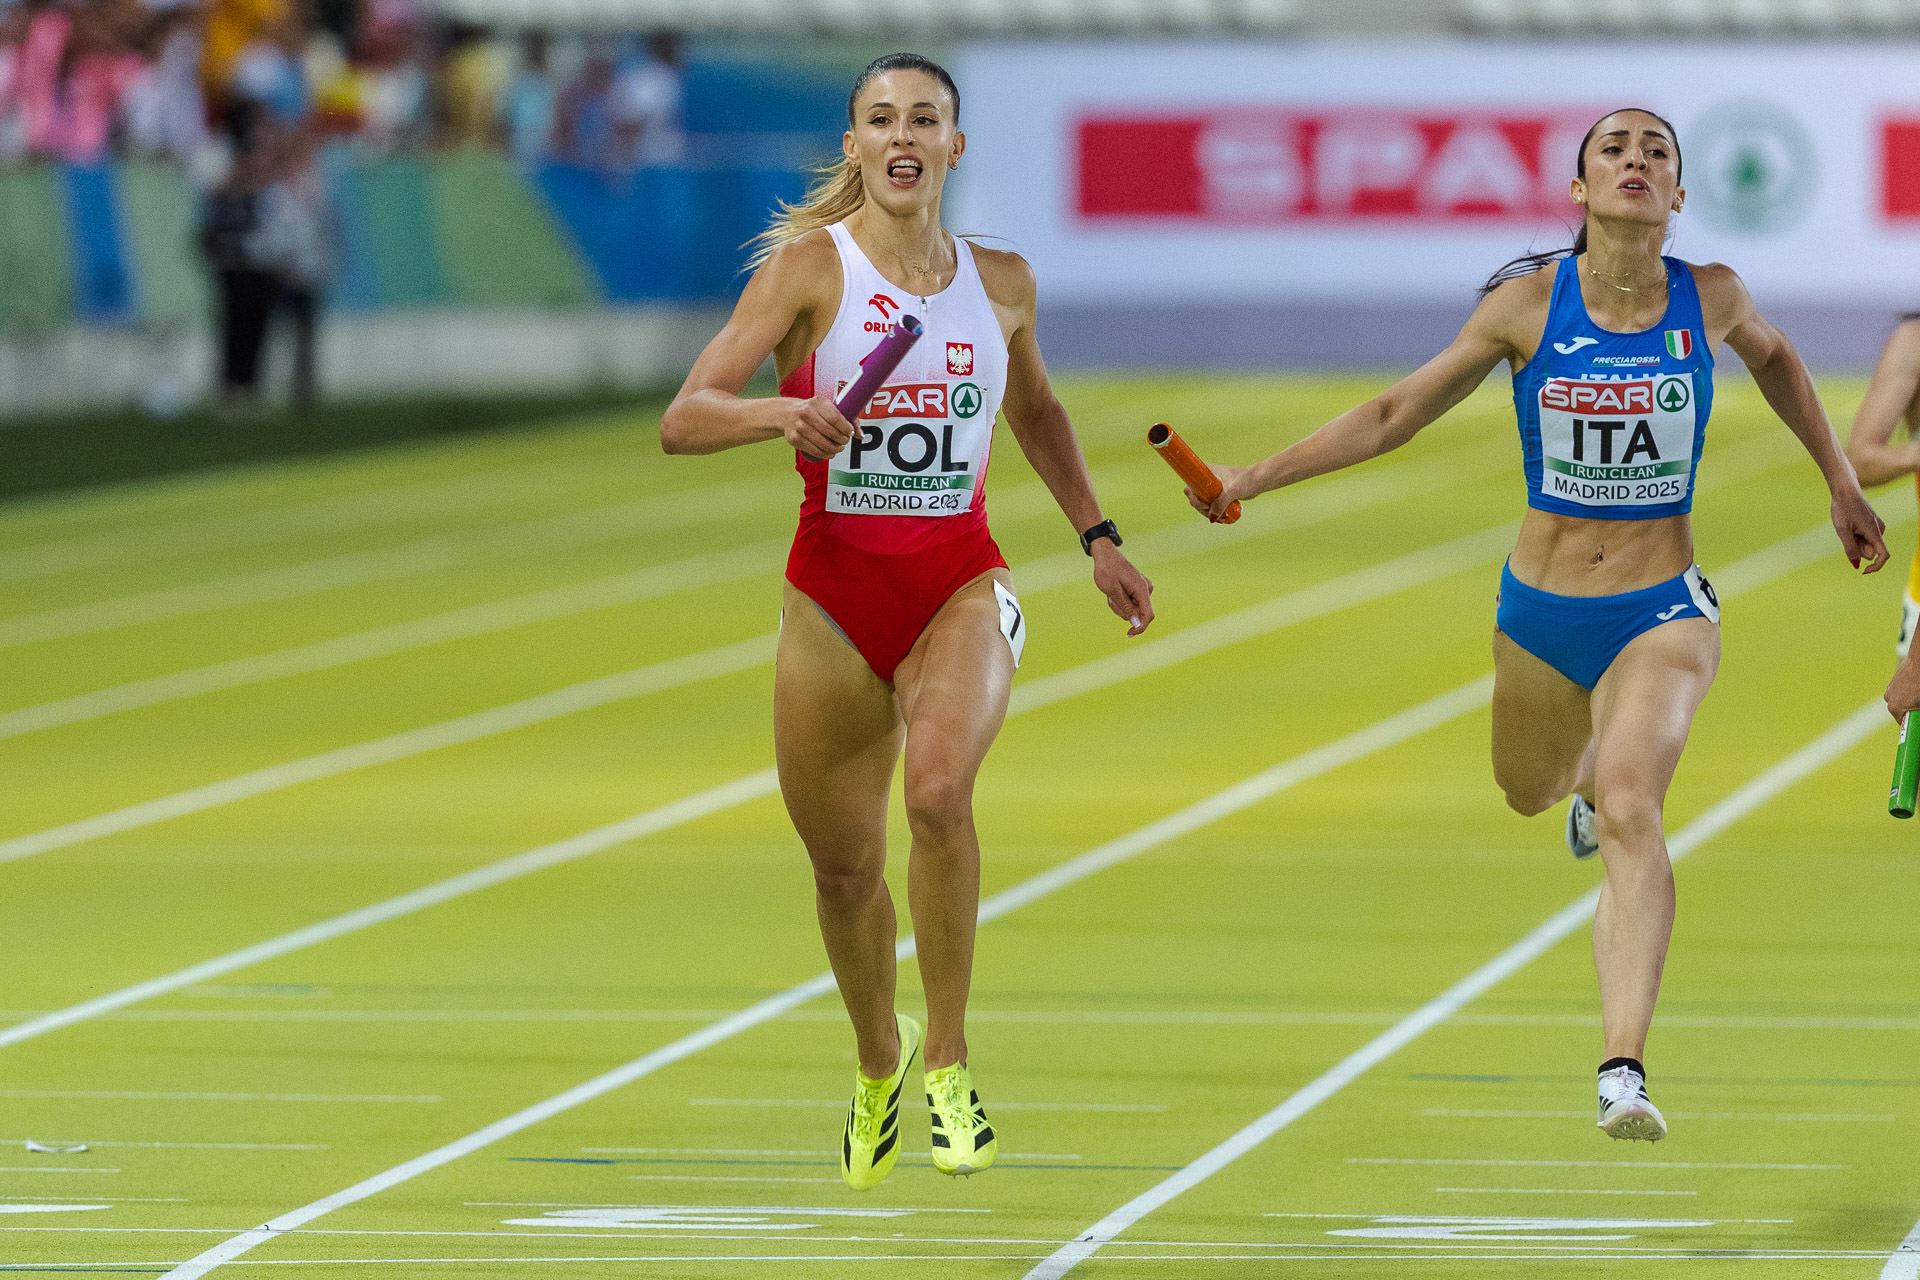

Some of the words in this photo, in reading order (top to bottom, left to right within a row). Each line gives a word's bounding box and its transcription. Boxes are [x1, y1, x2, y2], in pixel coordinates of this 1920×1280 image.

[1592, 356, 1661, 364] FRECCIAROSSA
[865, 388, 945, 415] PAR
[1544, 384, 1651, 411] SPAR
[849, 422, 969, 473] POL
[1572, 418, 1661, 464] ITA
[868, 474, 899, 488] RUN
[1576, 465, 1607, 479] RUN
[1554, 476, 1630, 500] MADRID
[1635, 480, 1680, 499] 2025
[840, 491, 923, 510] MADRID
